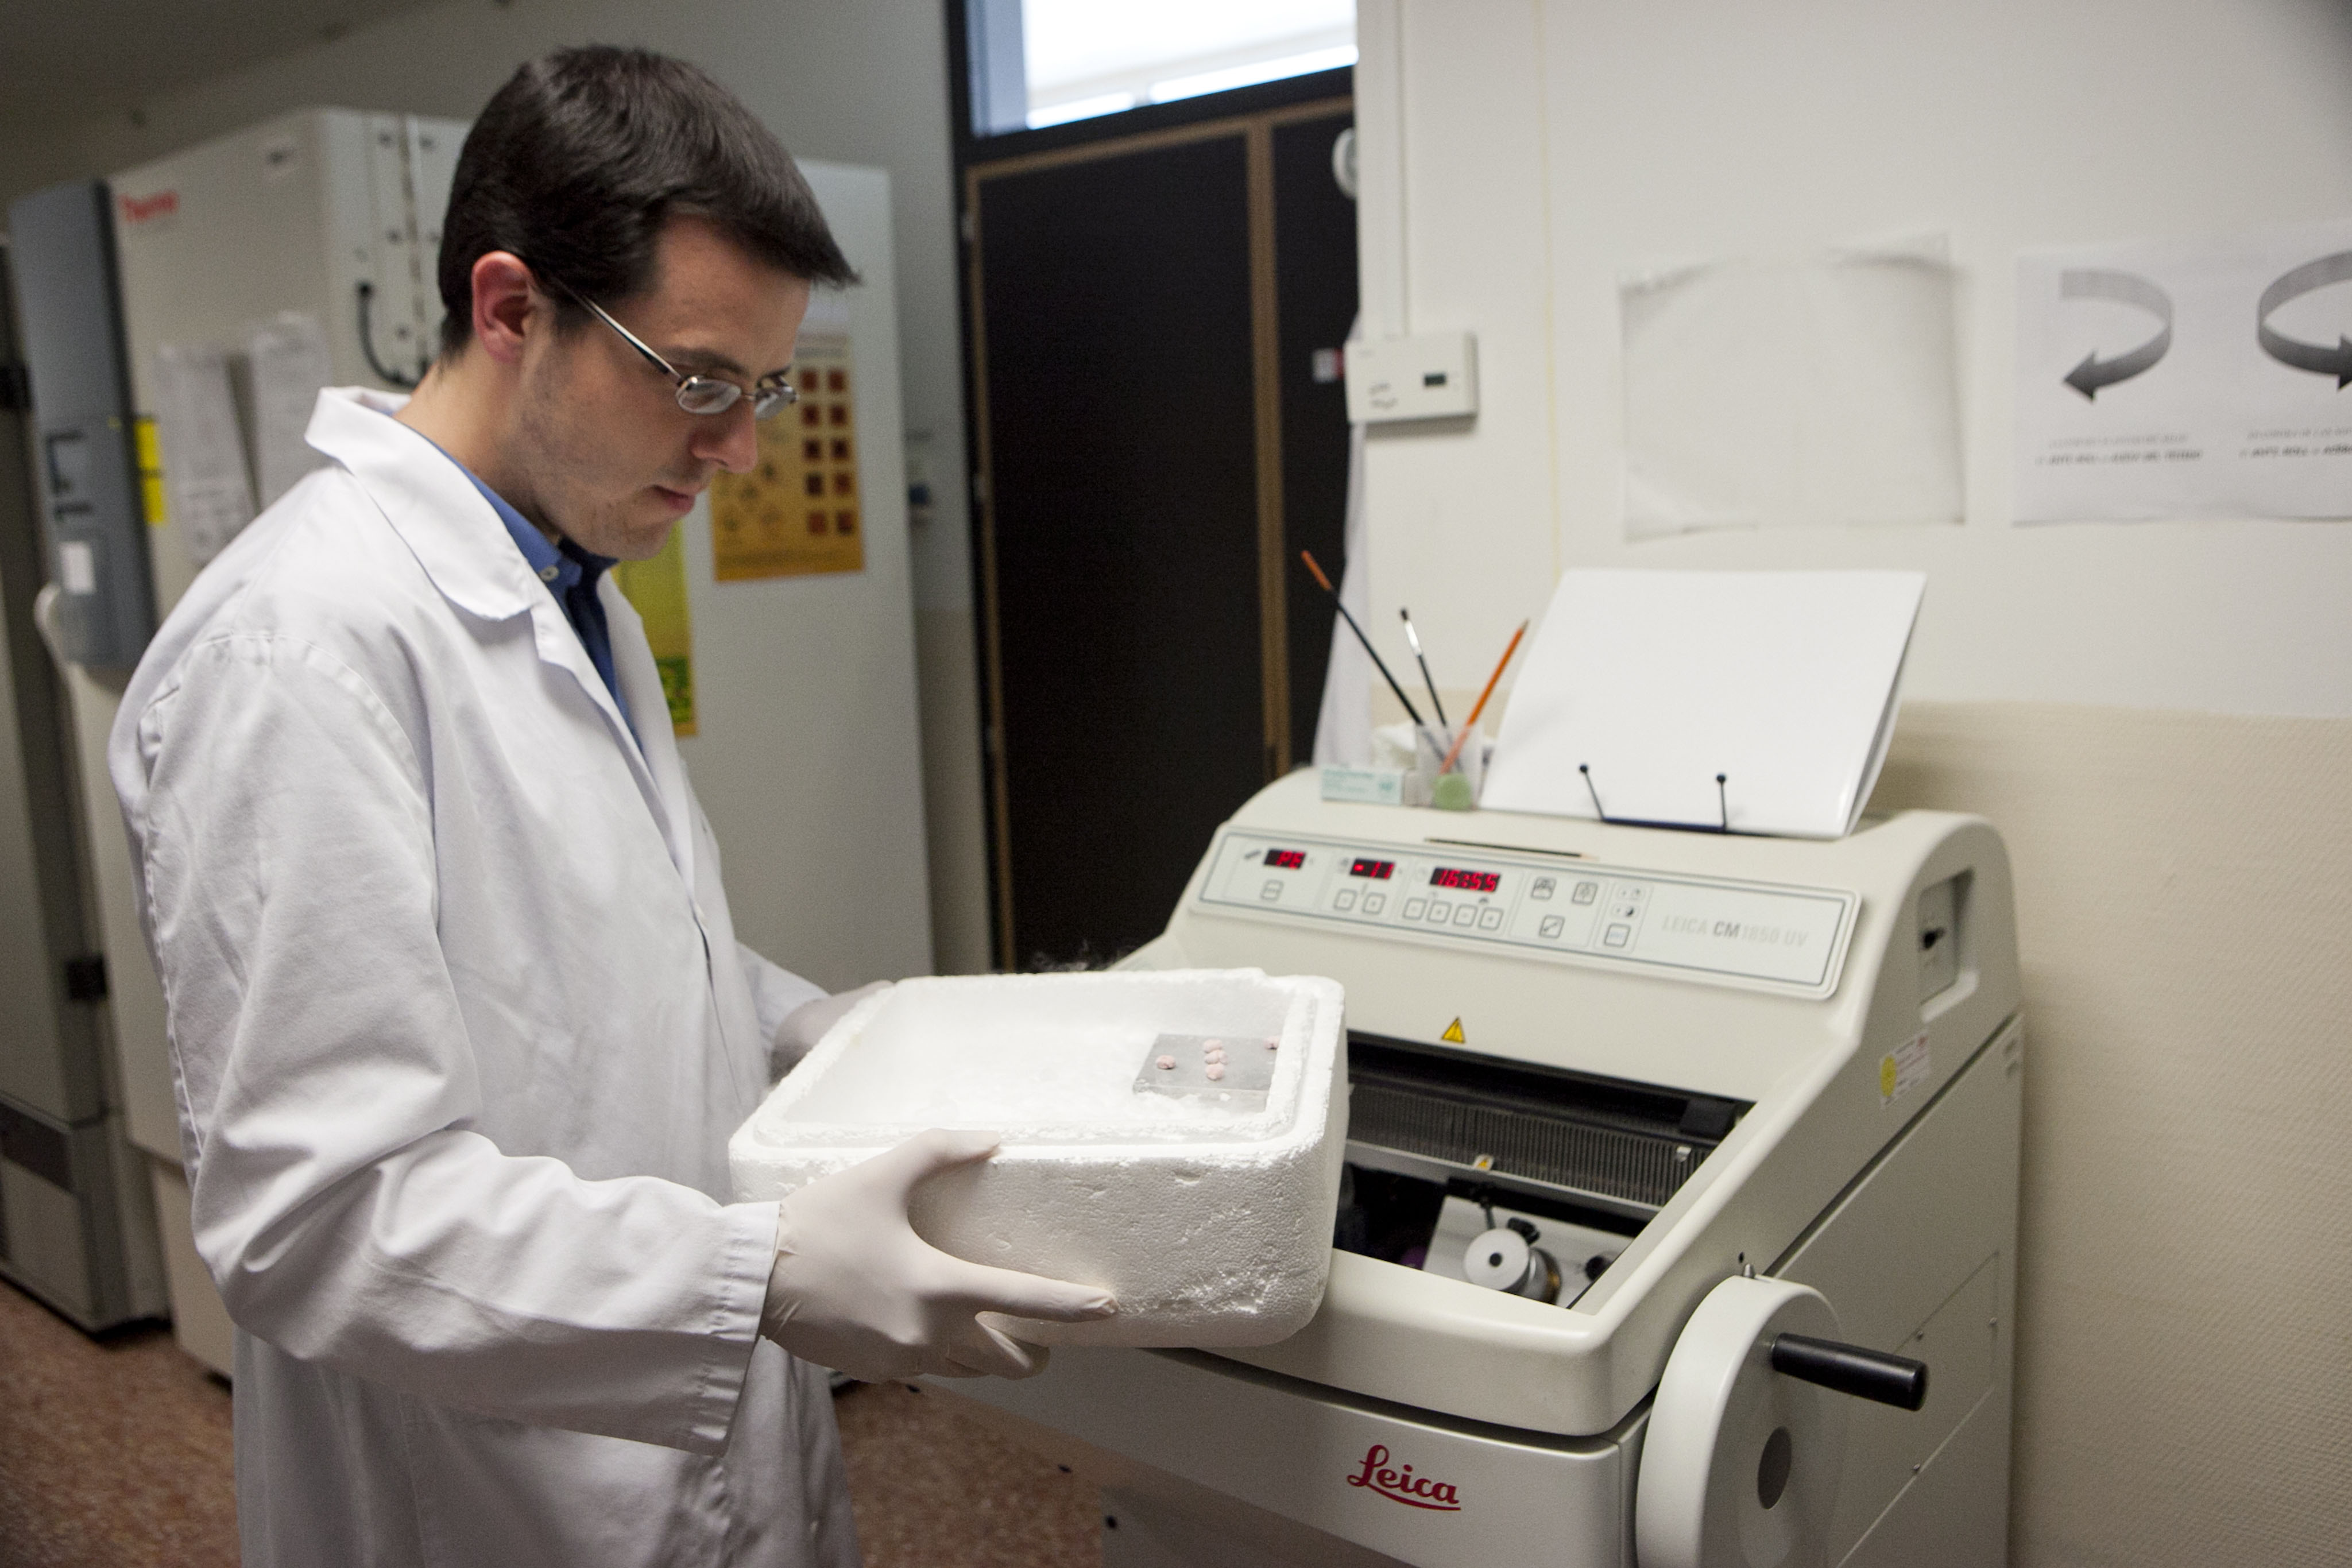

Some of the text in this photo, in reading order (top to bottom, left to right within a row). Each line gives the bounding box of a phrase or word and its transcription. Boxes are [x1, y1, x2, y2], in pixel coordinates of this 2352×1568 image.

[1437, 869, 1498, 893] 16:55
[1661, 915, 1708, 935] LEICA
[1783, 928, 1810, 948] UV
[1347, 1445, 1461, 1511] Leica
